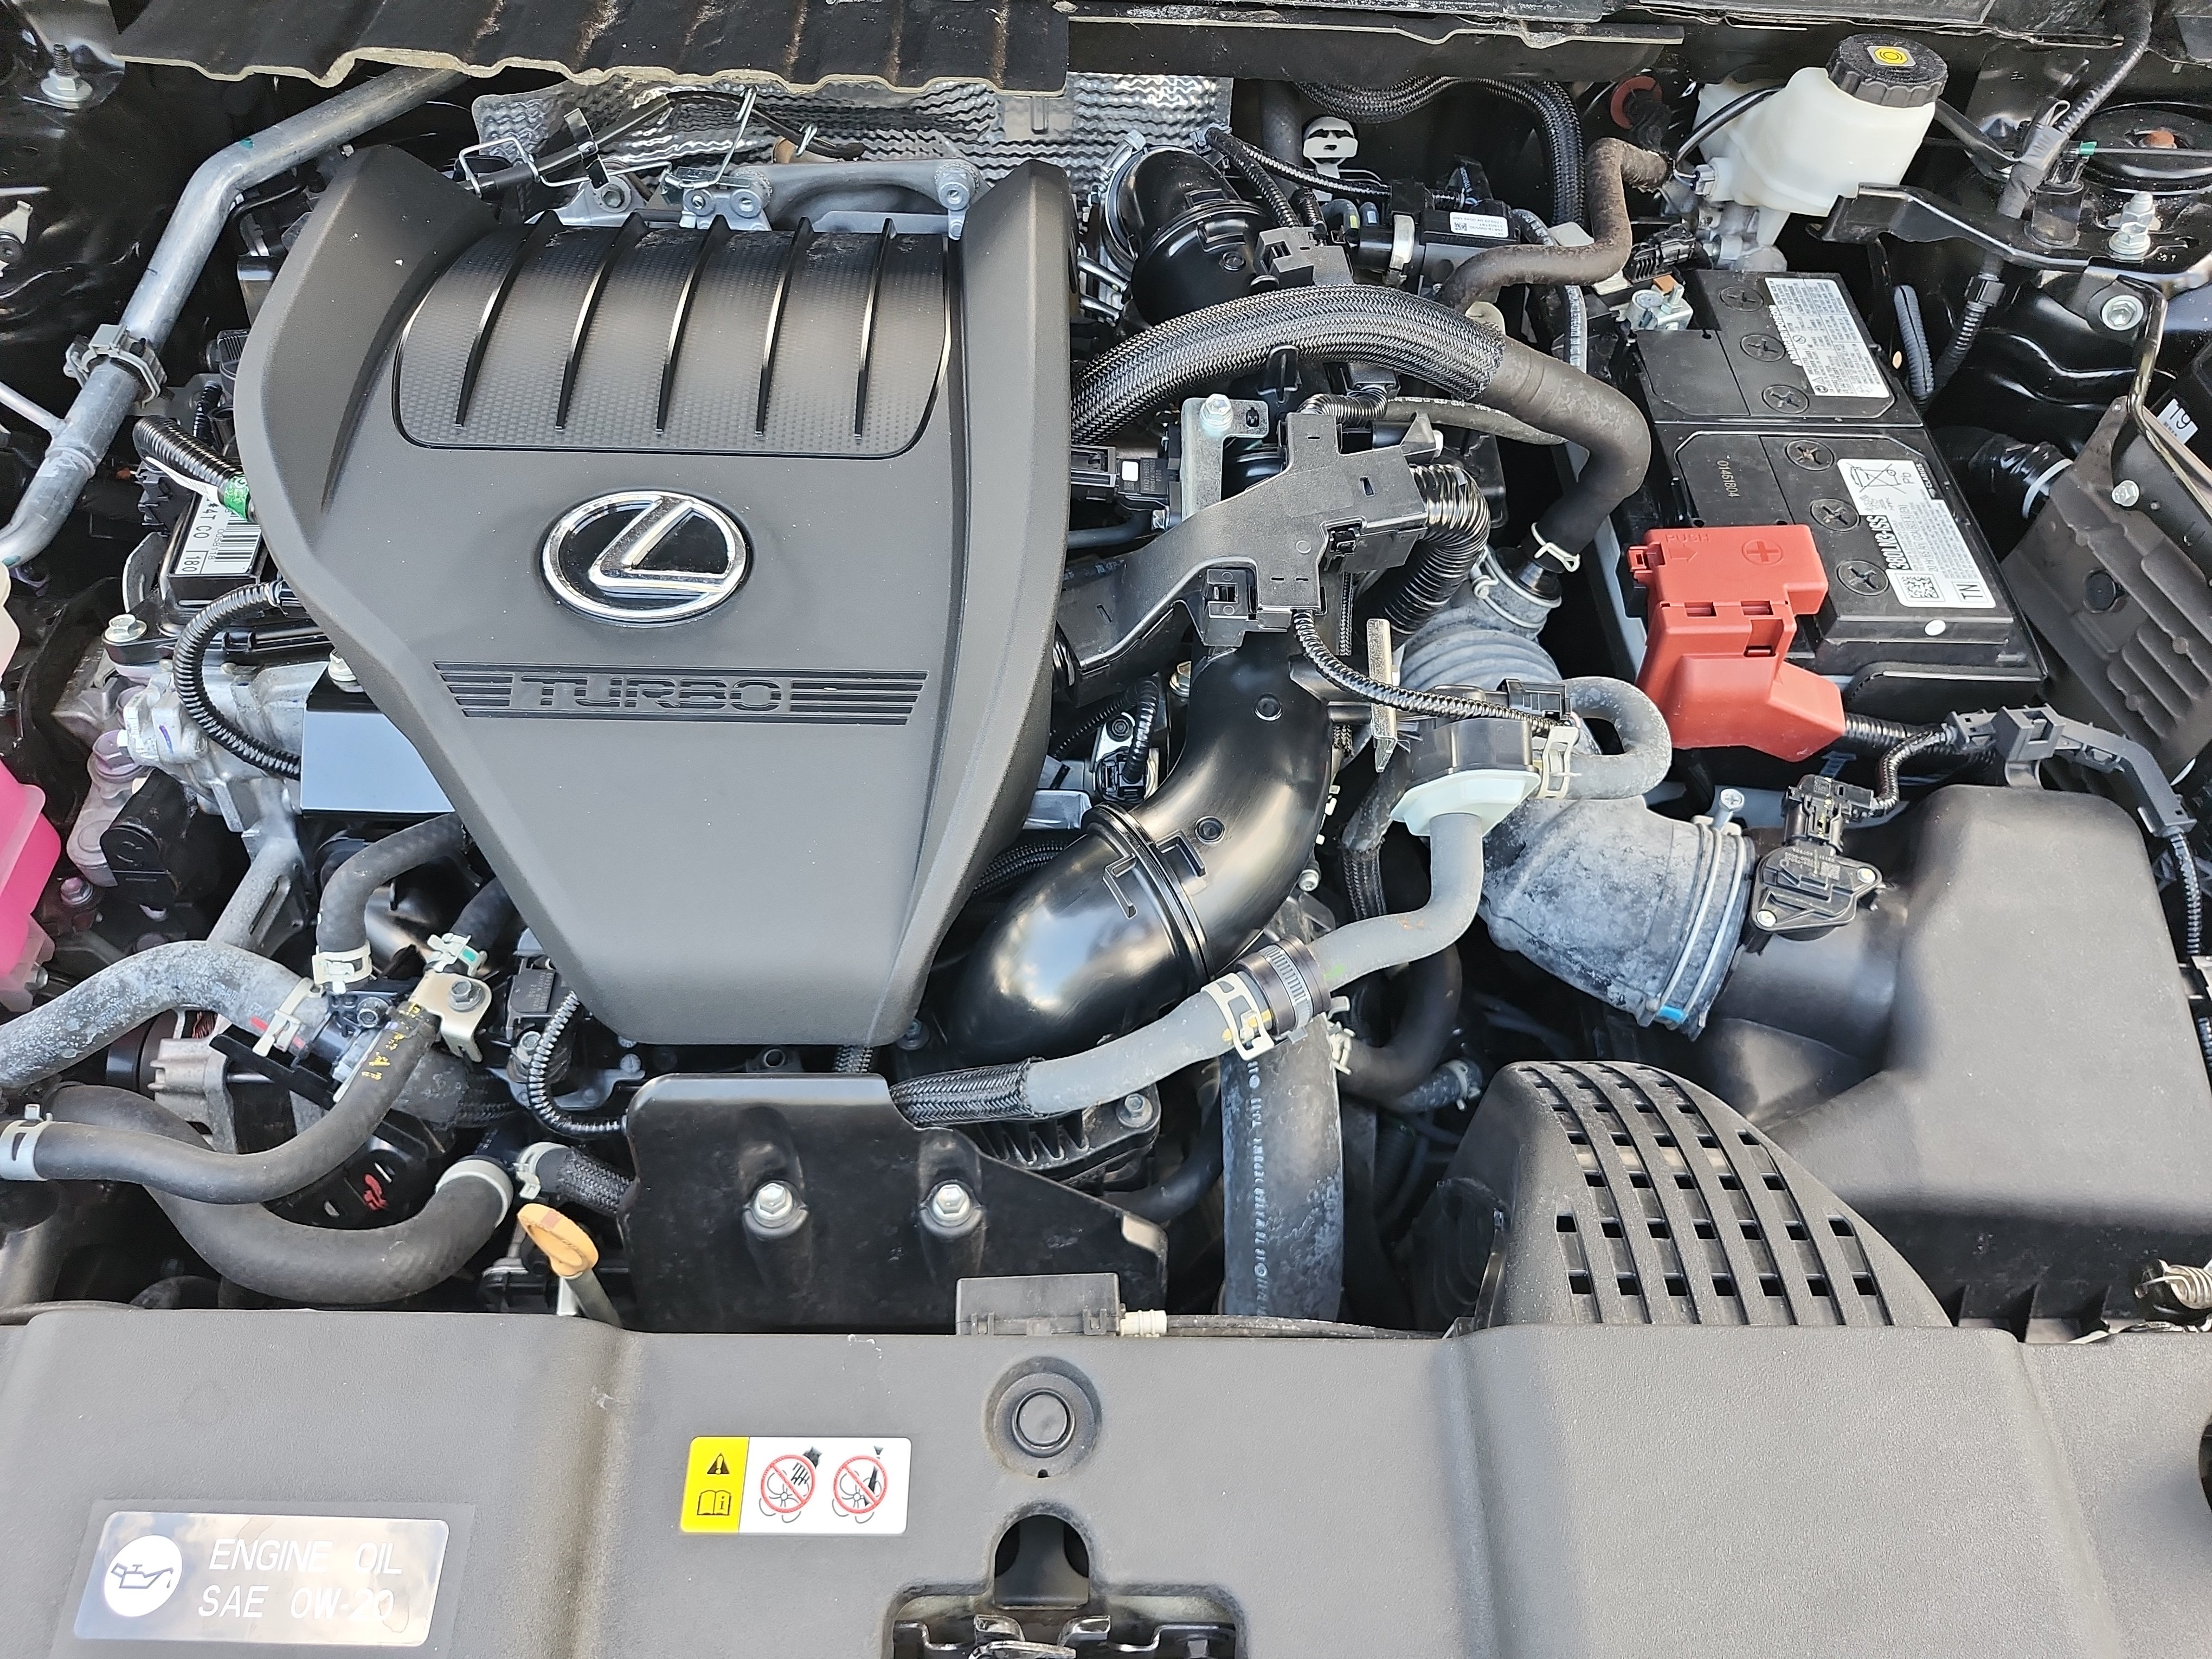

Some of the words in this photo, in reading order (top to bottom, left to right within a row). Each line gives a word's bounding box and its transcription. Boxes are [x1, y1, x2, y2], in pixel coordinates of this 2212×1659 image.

[1769, 305, 1798, 359] DANGER/POISON
[1902, 472, 1914, 484] Pb
[1915, 462, 1933, 488] CLARIOS
[208, 529, 226, 560] 0058118
[1665, 533, 1710, 543] PUSH
[1866, 516, 1910, 569] 380LN3-ISS
[182, 556, 202, 572] 180
[1956, 584, 1984, 600] TN
[521, 676, 782, 712] TURBO
[209, 1538, 333, 1574] ENGINE
[355, 1542, 403, 1575] OIL
[198, 1585, 269, 1618] SAE
[291, 1586, 395, 1621] 0W-20
